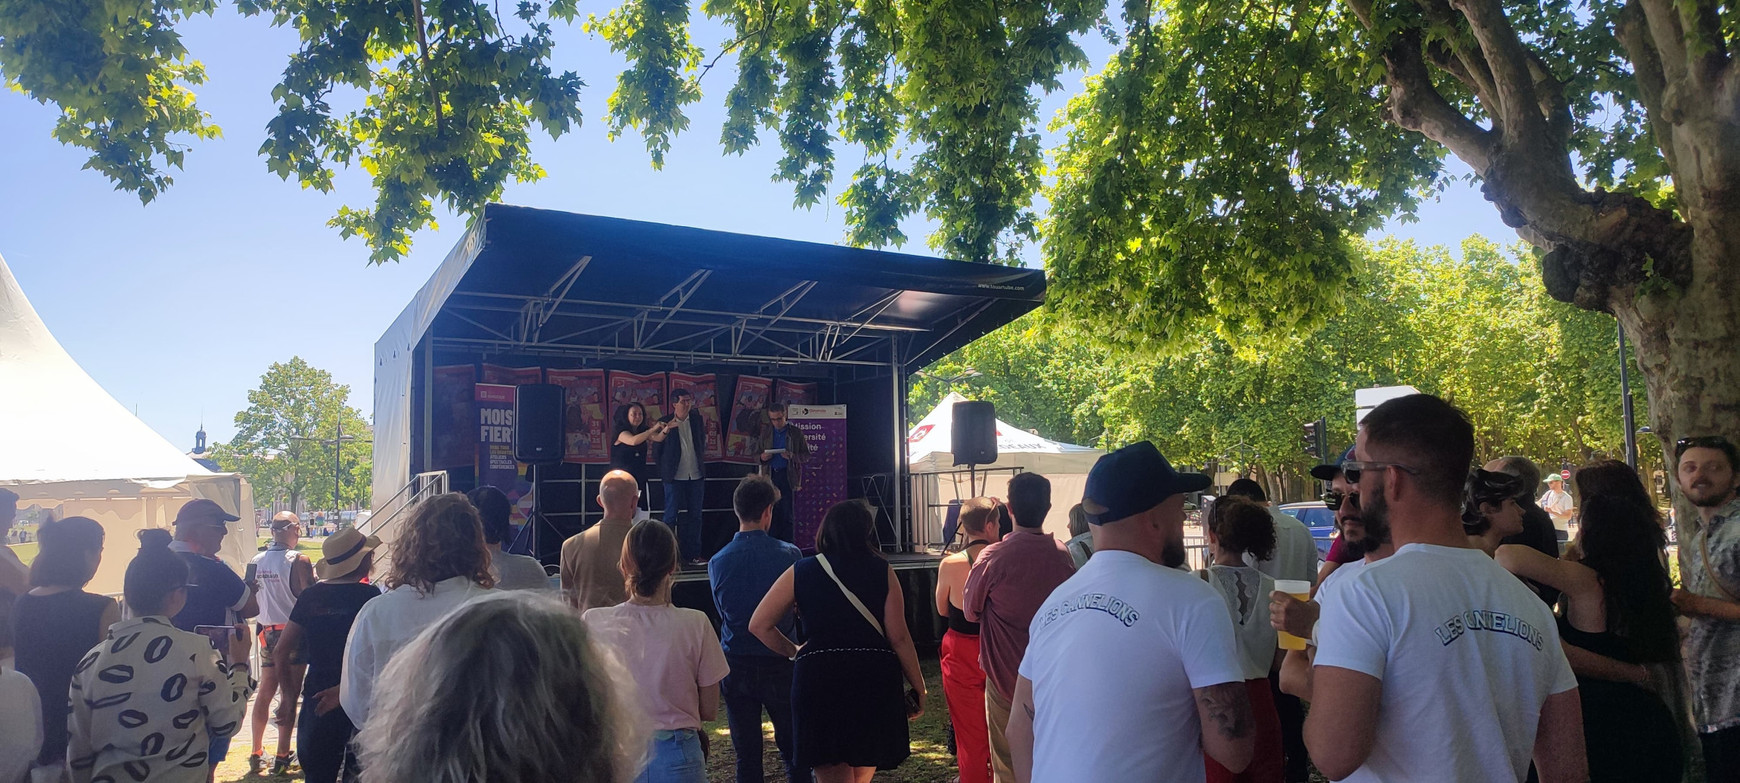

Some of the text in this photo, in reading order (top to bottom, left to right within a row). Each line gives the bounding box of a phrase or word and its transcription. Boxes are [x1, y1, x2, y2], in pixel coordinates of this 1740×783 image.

[480, 408, 513, 426] MOIS
[480, 425, 514, 443] FIER
[803, 433, 827, 441] ersité
[1434, 615, 1465, 647] LES
